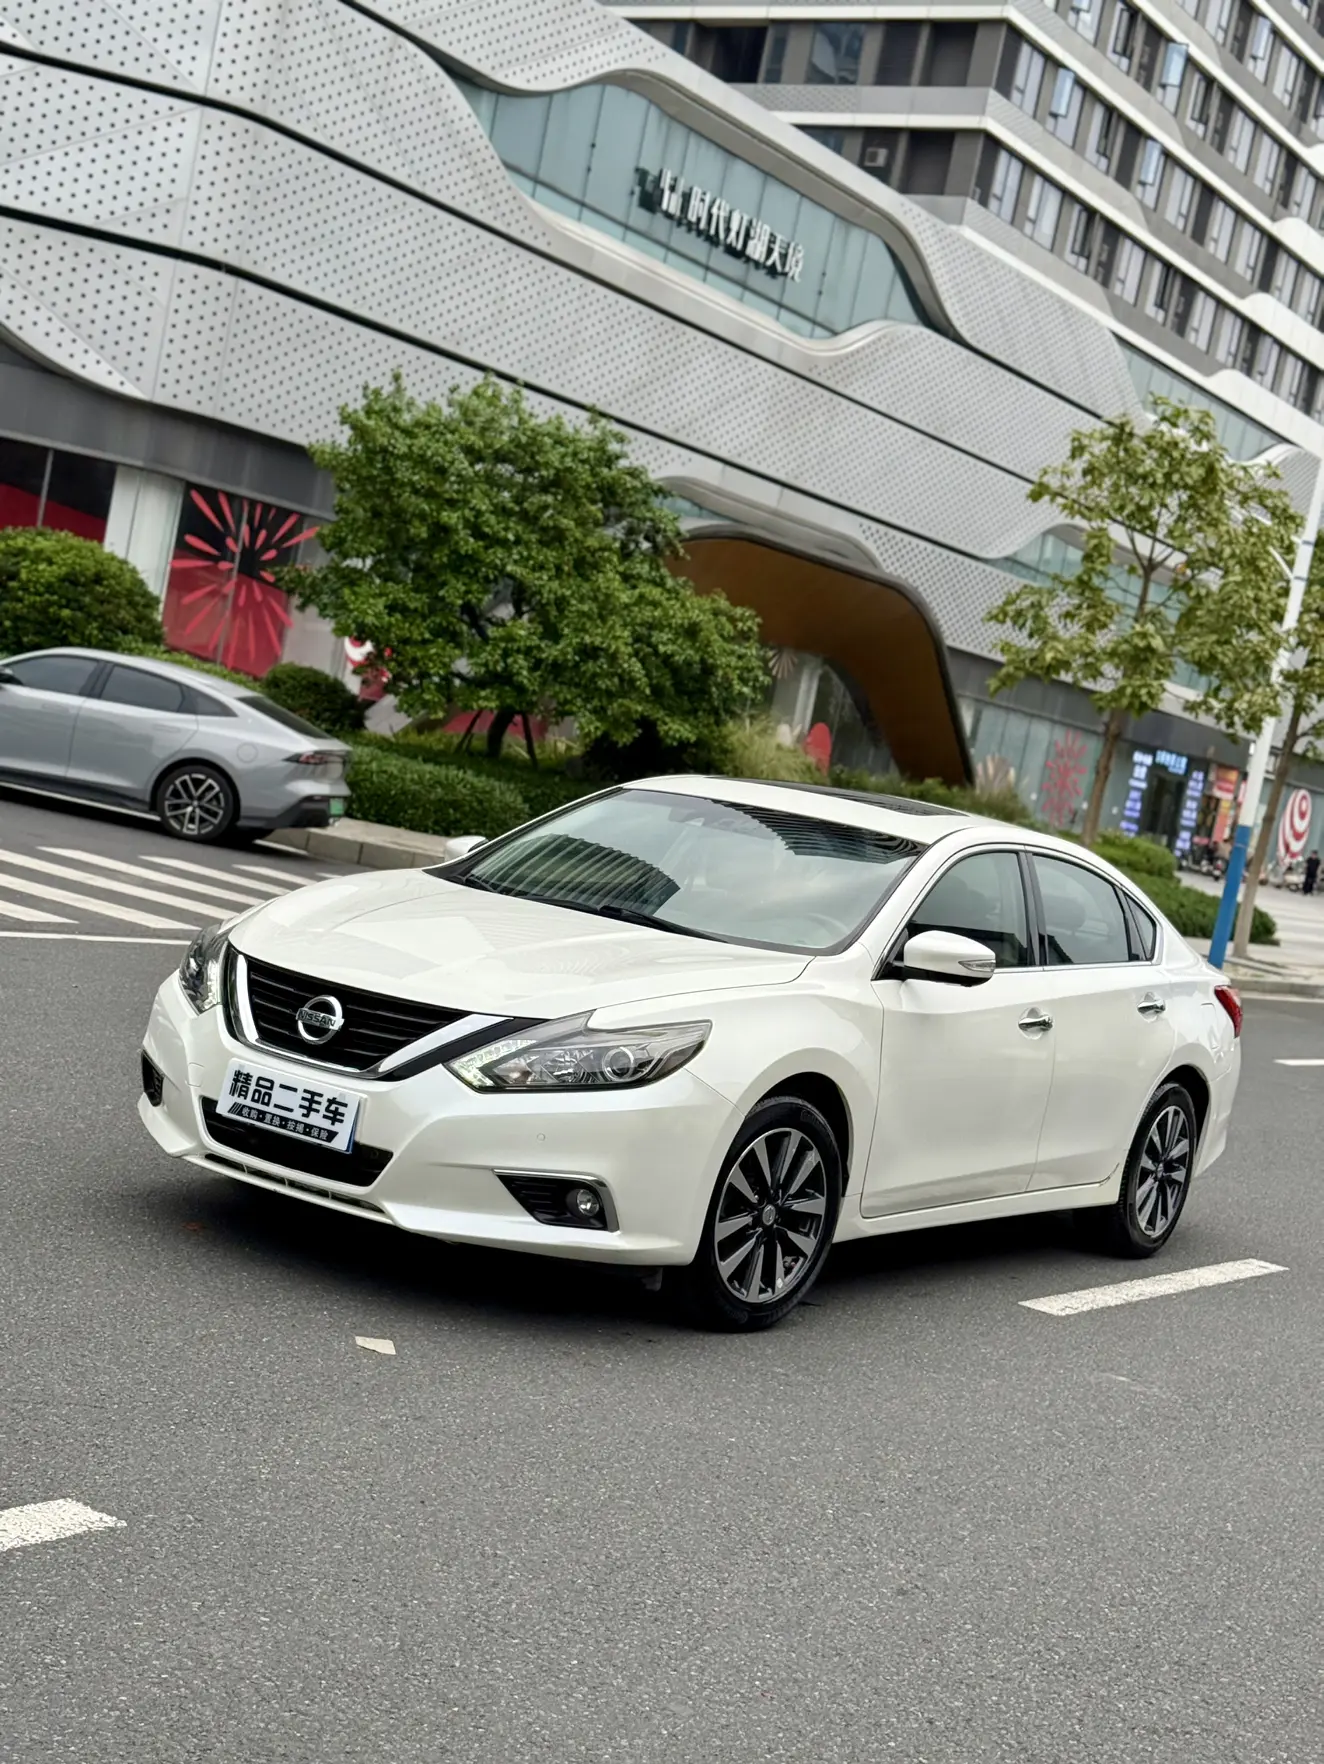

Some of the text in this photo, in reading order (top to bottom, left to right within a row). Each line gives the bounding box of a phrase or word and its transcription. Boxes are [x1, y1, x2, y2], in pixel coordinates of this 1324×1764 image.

[298, 1009, 336, 1027] NISSAN
[228, 1069, 349, 1126] 精品二手车
